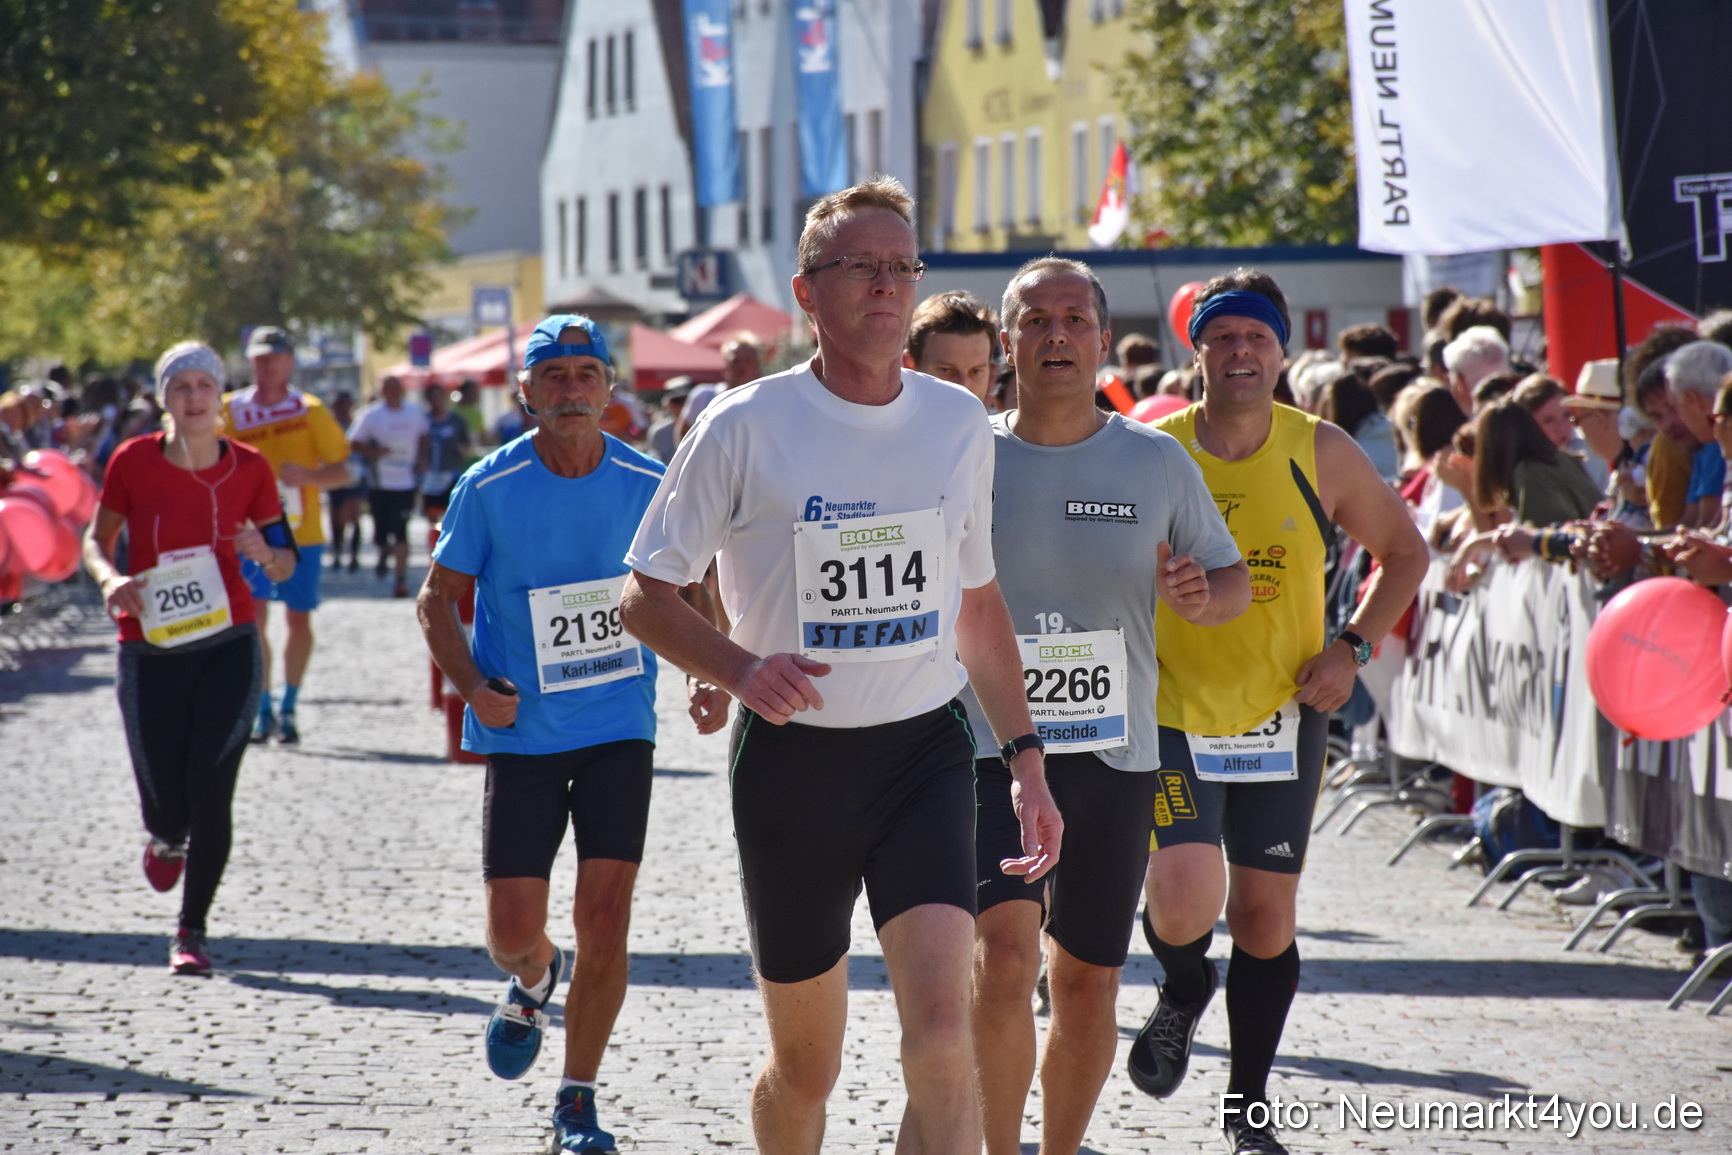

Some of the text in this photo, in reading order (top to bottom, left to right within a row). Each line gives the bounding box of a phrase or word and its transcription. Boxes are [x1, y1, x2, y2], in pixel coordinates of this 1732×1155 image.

[804, 495, 831, 522] 6.
[825, 500, 876, 512] Neumarkter
[1066, 501, 1137, 518] BOCK
[840, 525, 905, 547] BOCK
[820, 550, 926, 602] 3114
[1249, 573, 1281, 588] ZZERIA
[155, 581, 204, 613] 266
[562, 590, 611, 606] BOCK
[831, 603, 908, 617] PARTL Neumarkt
[550, 606, 623, 647] 2139
[1034, 612, 1072, 634] 19.
[812, 617, 927, 648] STEFAN
[561, 644, 614, 658] PARTL Neumarkt
[1040, 644, 1093, 658] BOCK
[562, 657, 624, 679] Karl-Heinz
[1023, 665, 1110, 703] 2266
[1030, 708, 1095, 717] PARTL Neumarkt
[1038, 724, 1098, 740] Erschda
[1234, 742, 1265, 750] Neumarkt
[1223, 757, 1261, 771] Alfred
[1165, 776, 1191, 814] Run!
[1156, 795, 1170, 823] Team
[1264, 848, 1295, 858] adidas
